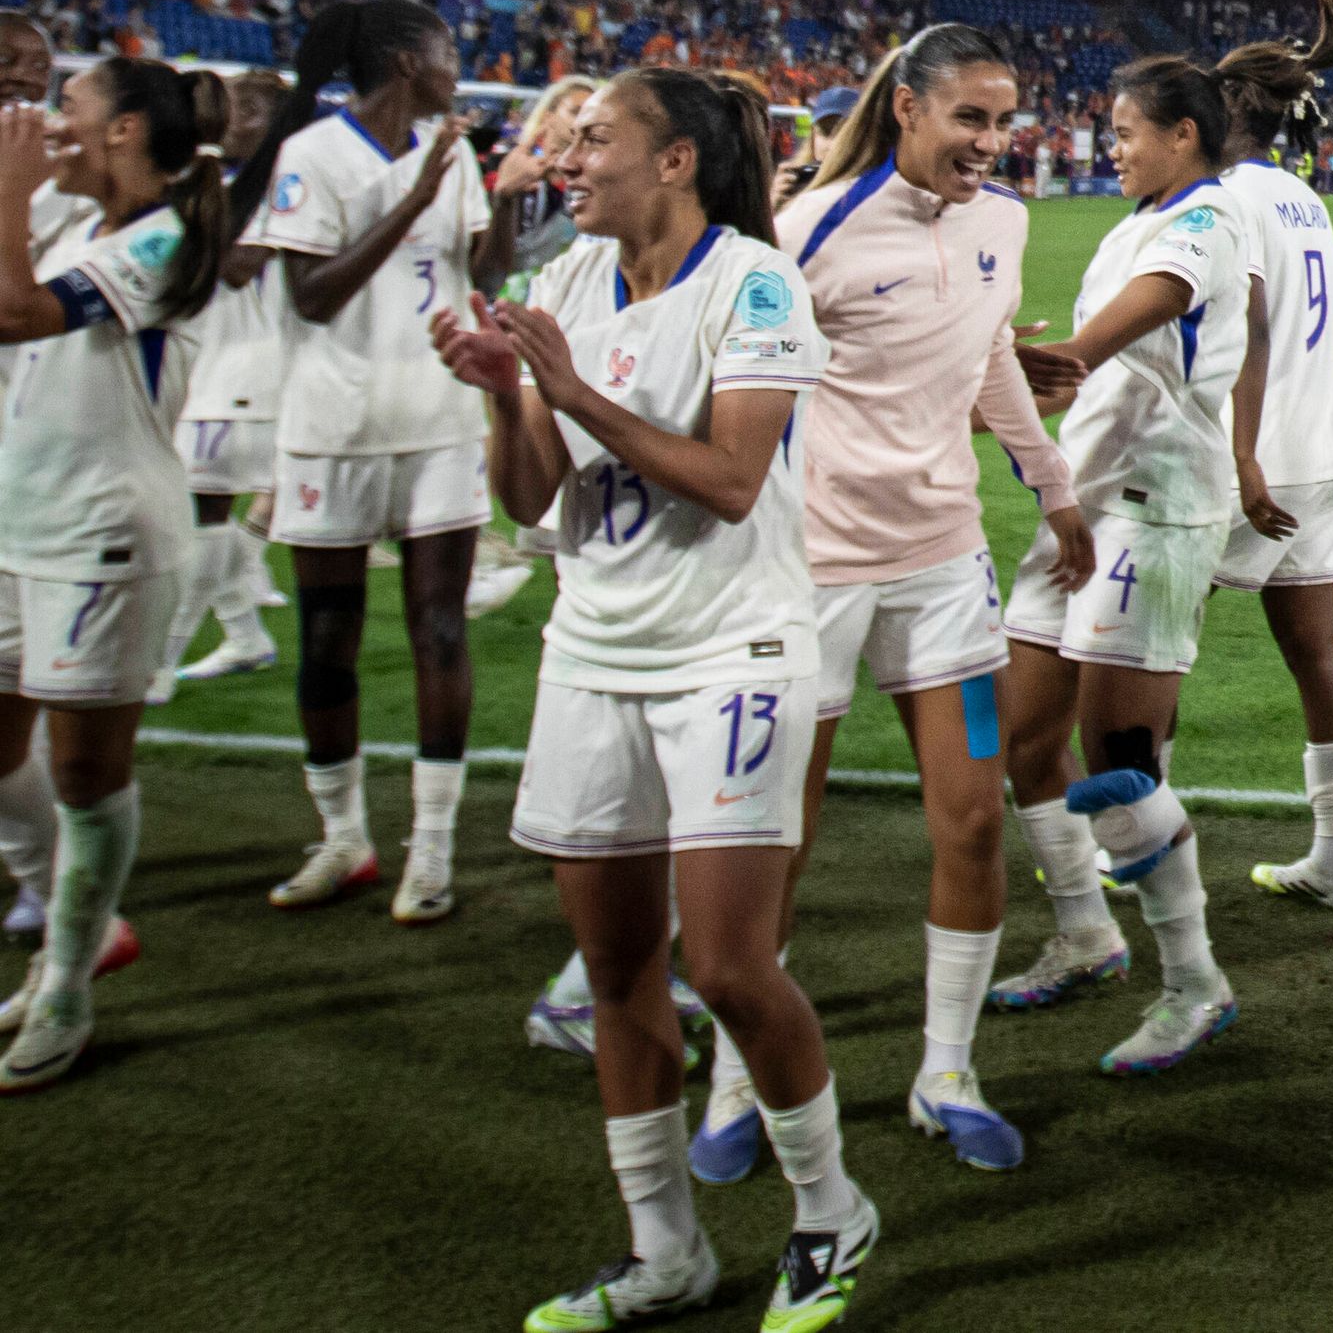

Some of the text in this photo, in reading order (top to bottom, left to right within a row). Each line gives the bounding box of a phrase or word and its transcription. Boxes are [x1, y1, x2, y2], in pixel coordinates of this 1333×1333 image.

[414, 260, 437, 315] 3
[1304, 250, 1328, 354] 9
[596, 463, 650, 546] 13
[67, 581, 106, 648] 7
[1107, 548, 1137, 614] 4
[720, 692, 778, 778] 13
